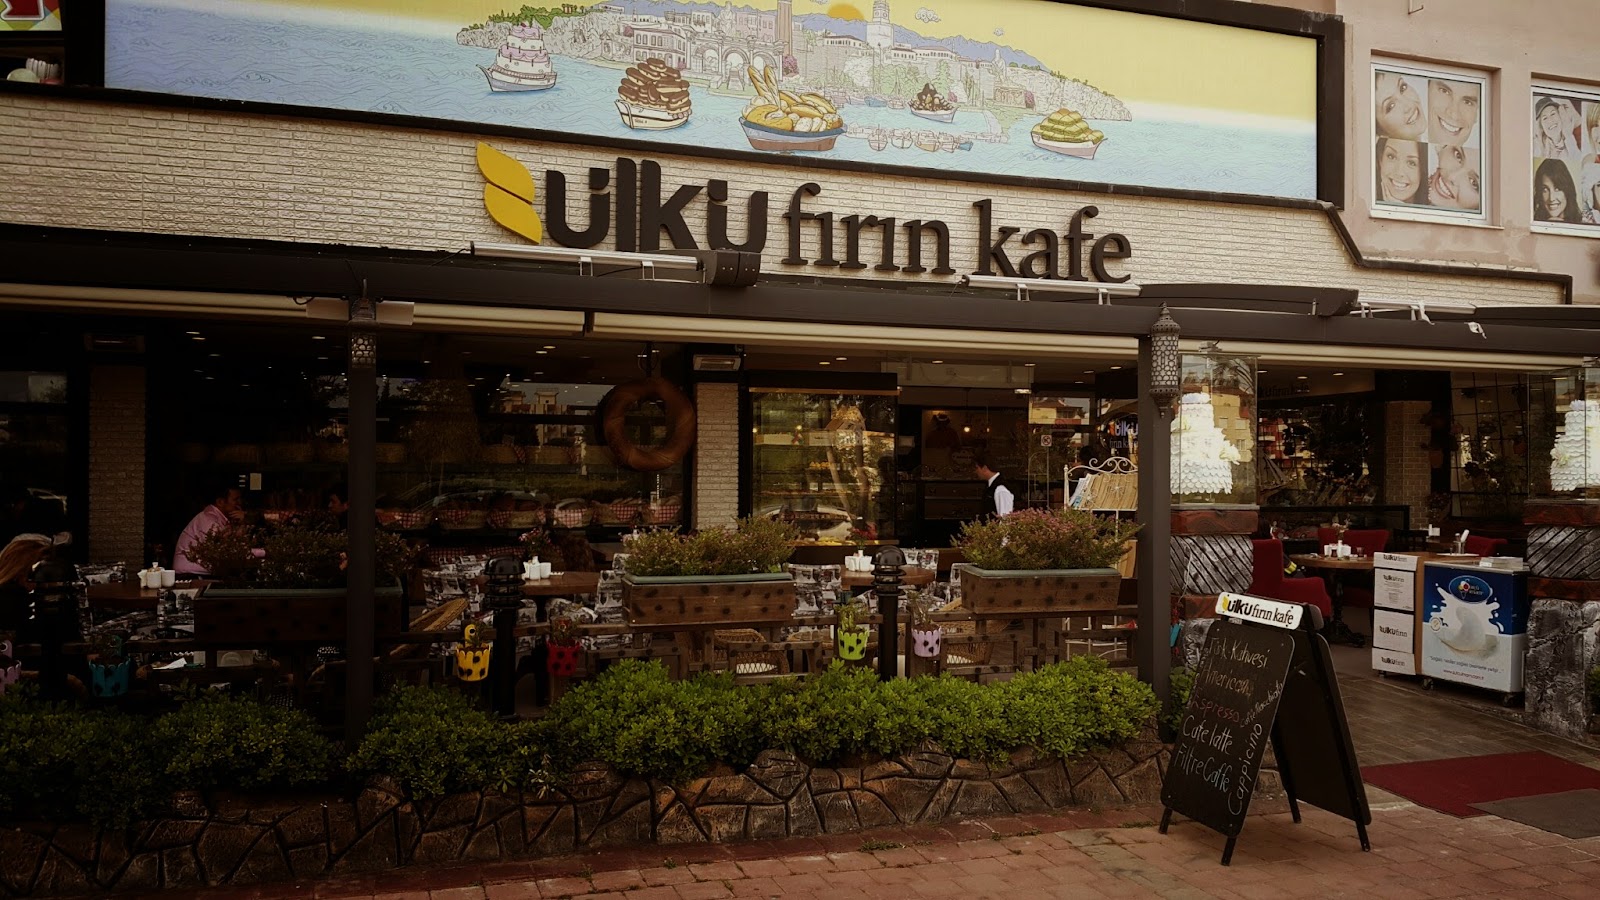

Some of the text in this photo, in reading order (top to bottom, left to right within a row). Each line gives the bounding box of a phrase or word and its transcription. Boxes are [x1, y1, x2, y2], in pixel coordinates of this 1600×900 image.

[972, 199, 1132, 283] kafe
[1272, 608, 1294, 625] kafe
[1182, 714, 1210, 743] Cafe
